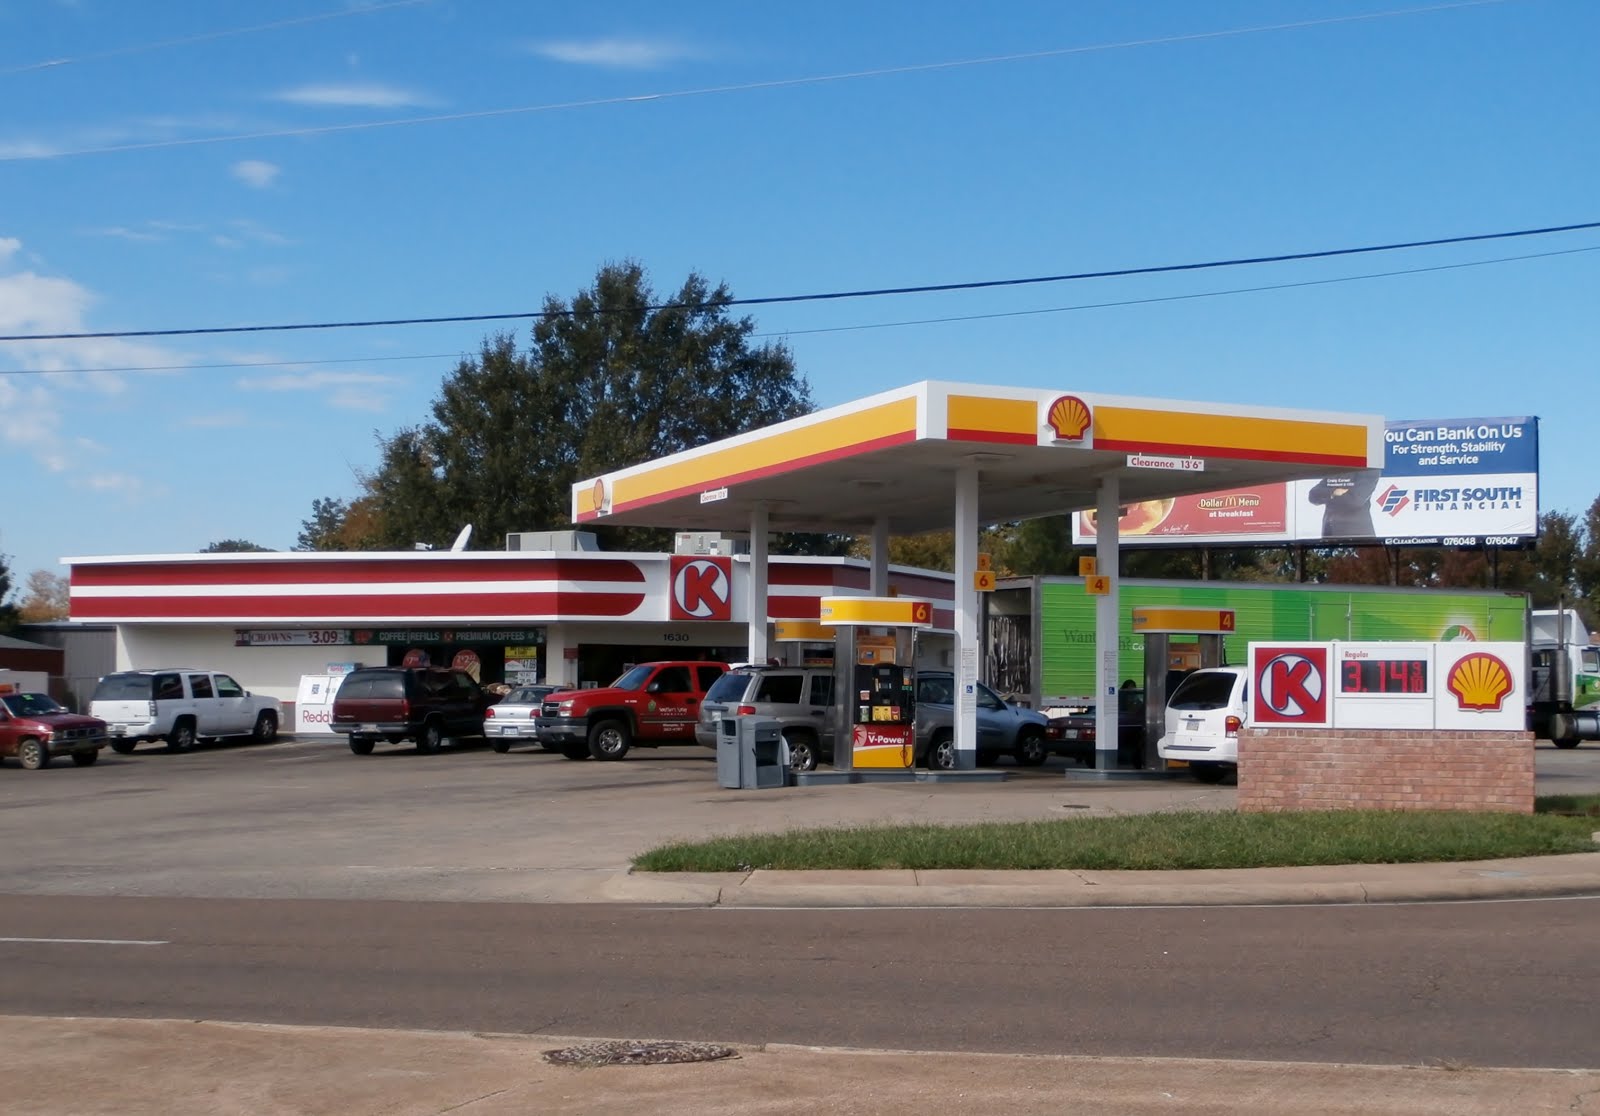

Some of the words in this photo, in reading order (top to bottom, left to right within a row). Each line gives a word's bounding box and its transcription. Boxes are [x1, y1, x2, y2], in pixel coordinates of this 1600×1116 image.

[1406, 429, 1434, 442] Can
[1437, 427, 1475, 440] Bank
[1478, 426, 1499, 439] On
[1502, 425, 1522, 438] Us
[1393, 445, 1409, 454] For
[1411, 443, 1459, 455] Strength,
[1461, 442, 1506, 453] Stability
[1131, 457, 1175, 468] Clearance
[1419, 456, 1438, 466] and
[1439, 455, 1479, 465] Service
[1414, 488, 1460, 502] FIRST
[1462, 487, 1521, 501] SOUTH
[1201, 499, 1223, 508] Dollar
[1239, 498, 1259, 506] Menu
[1414, 501, 1521, 511] FINANCIAL
[1218, 510, 1254, 518] breakfast
[1443, 537, 1476, 546] 076048
[1486, 536, 1518, 545] 076047
[979, 575, 989, 587] 6
[1094, 578, 1104, 591] 4
[684, 564, 727, 616] K
[917, 605, 927, 620] 6
[1223, 614, 1231, 628] 4
[251, 631, 292, 643] CROWNS
[308, 630, 338, 644] $3.09
[379, 632, 407, 641] COFFEE
[411, 632, 439, 641] REFILLS
[456, 631, 491, 640] PREMIUM
[492, 631, 525, 640] COFFEES
[664, 633, 689, 642] 1630
[1344, 651, 1369, 659] Regular
[1343, 660, 1408, 693] 3.14
[1271, 660, 1319, 714] K
[868, 735, 905, 744] V-Power
